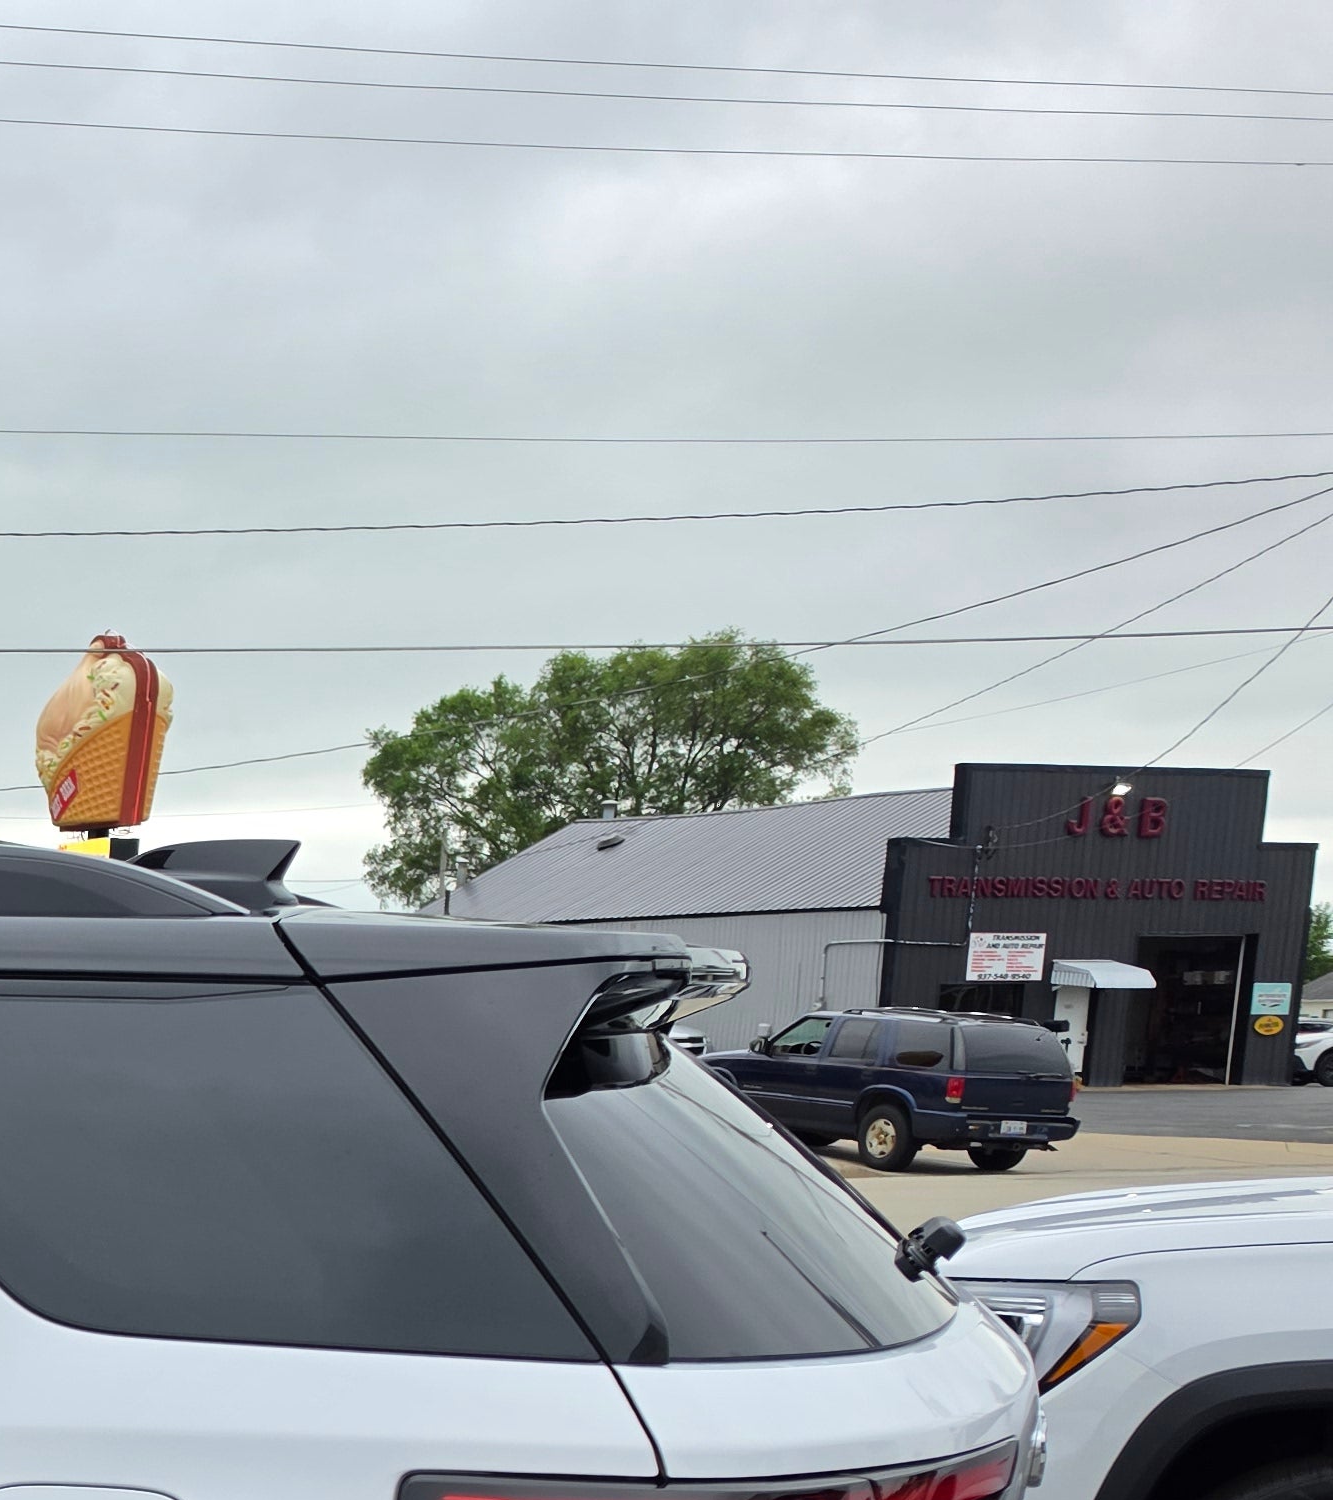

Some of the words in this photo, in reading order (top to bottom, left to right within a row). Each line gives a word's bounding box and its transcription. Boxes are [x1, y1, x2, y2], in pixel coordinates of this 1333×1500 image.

[1066, 796, 1094, 837] J
[1100, 796, 1129, 838] &
[1138, 797, 1168, 839] B
[929, 876, 1099, 899] TRANSMISSION
[1105, 878, 1121, 899] &
[1129, 878, 1186, 900] AUTO
[1194, 879, 1268, 902] REPAIR
